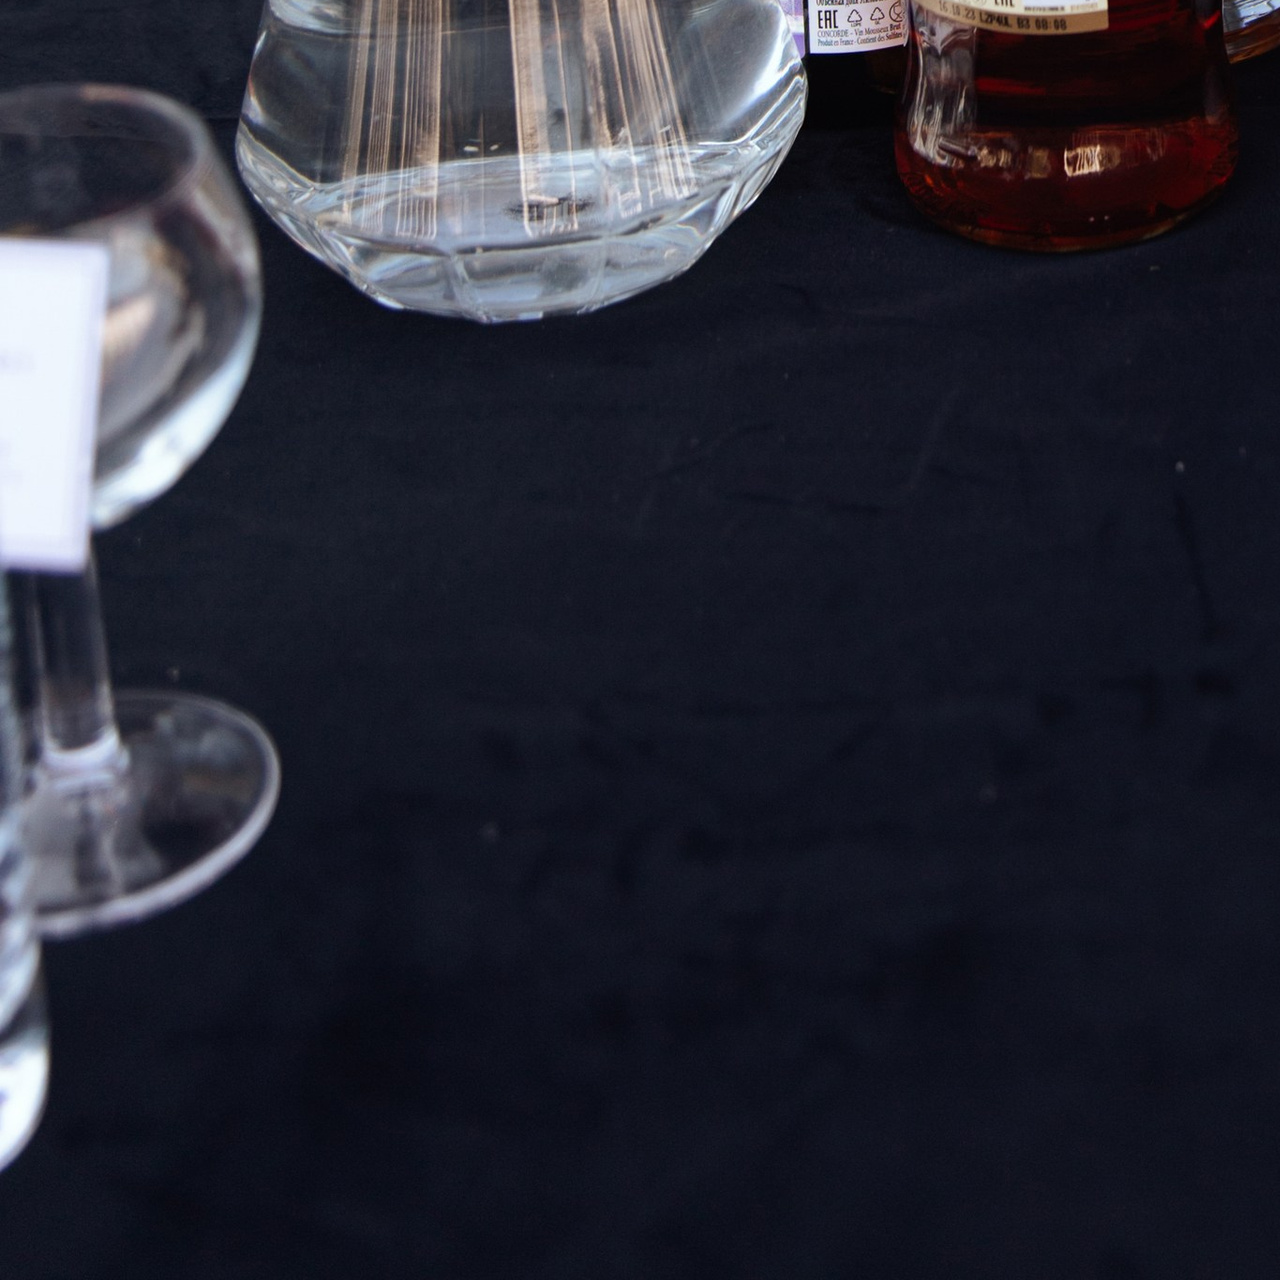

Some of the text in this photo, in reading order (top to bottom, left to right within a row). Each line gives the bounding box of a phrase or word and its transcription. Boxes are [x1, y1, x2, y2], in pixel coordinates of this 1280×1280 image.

[817, 9, 839, 29] EAC
[817, 29, 849, 38] CONCORDE
[854, 27, 864, 36] Vin
[817, 39, 833, 47] Produit
